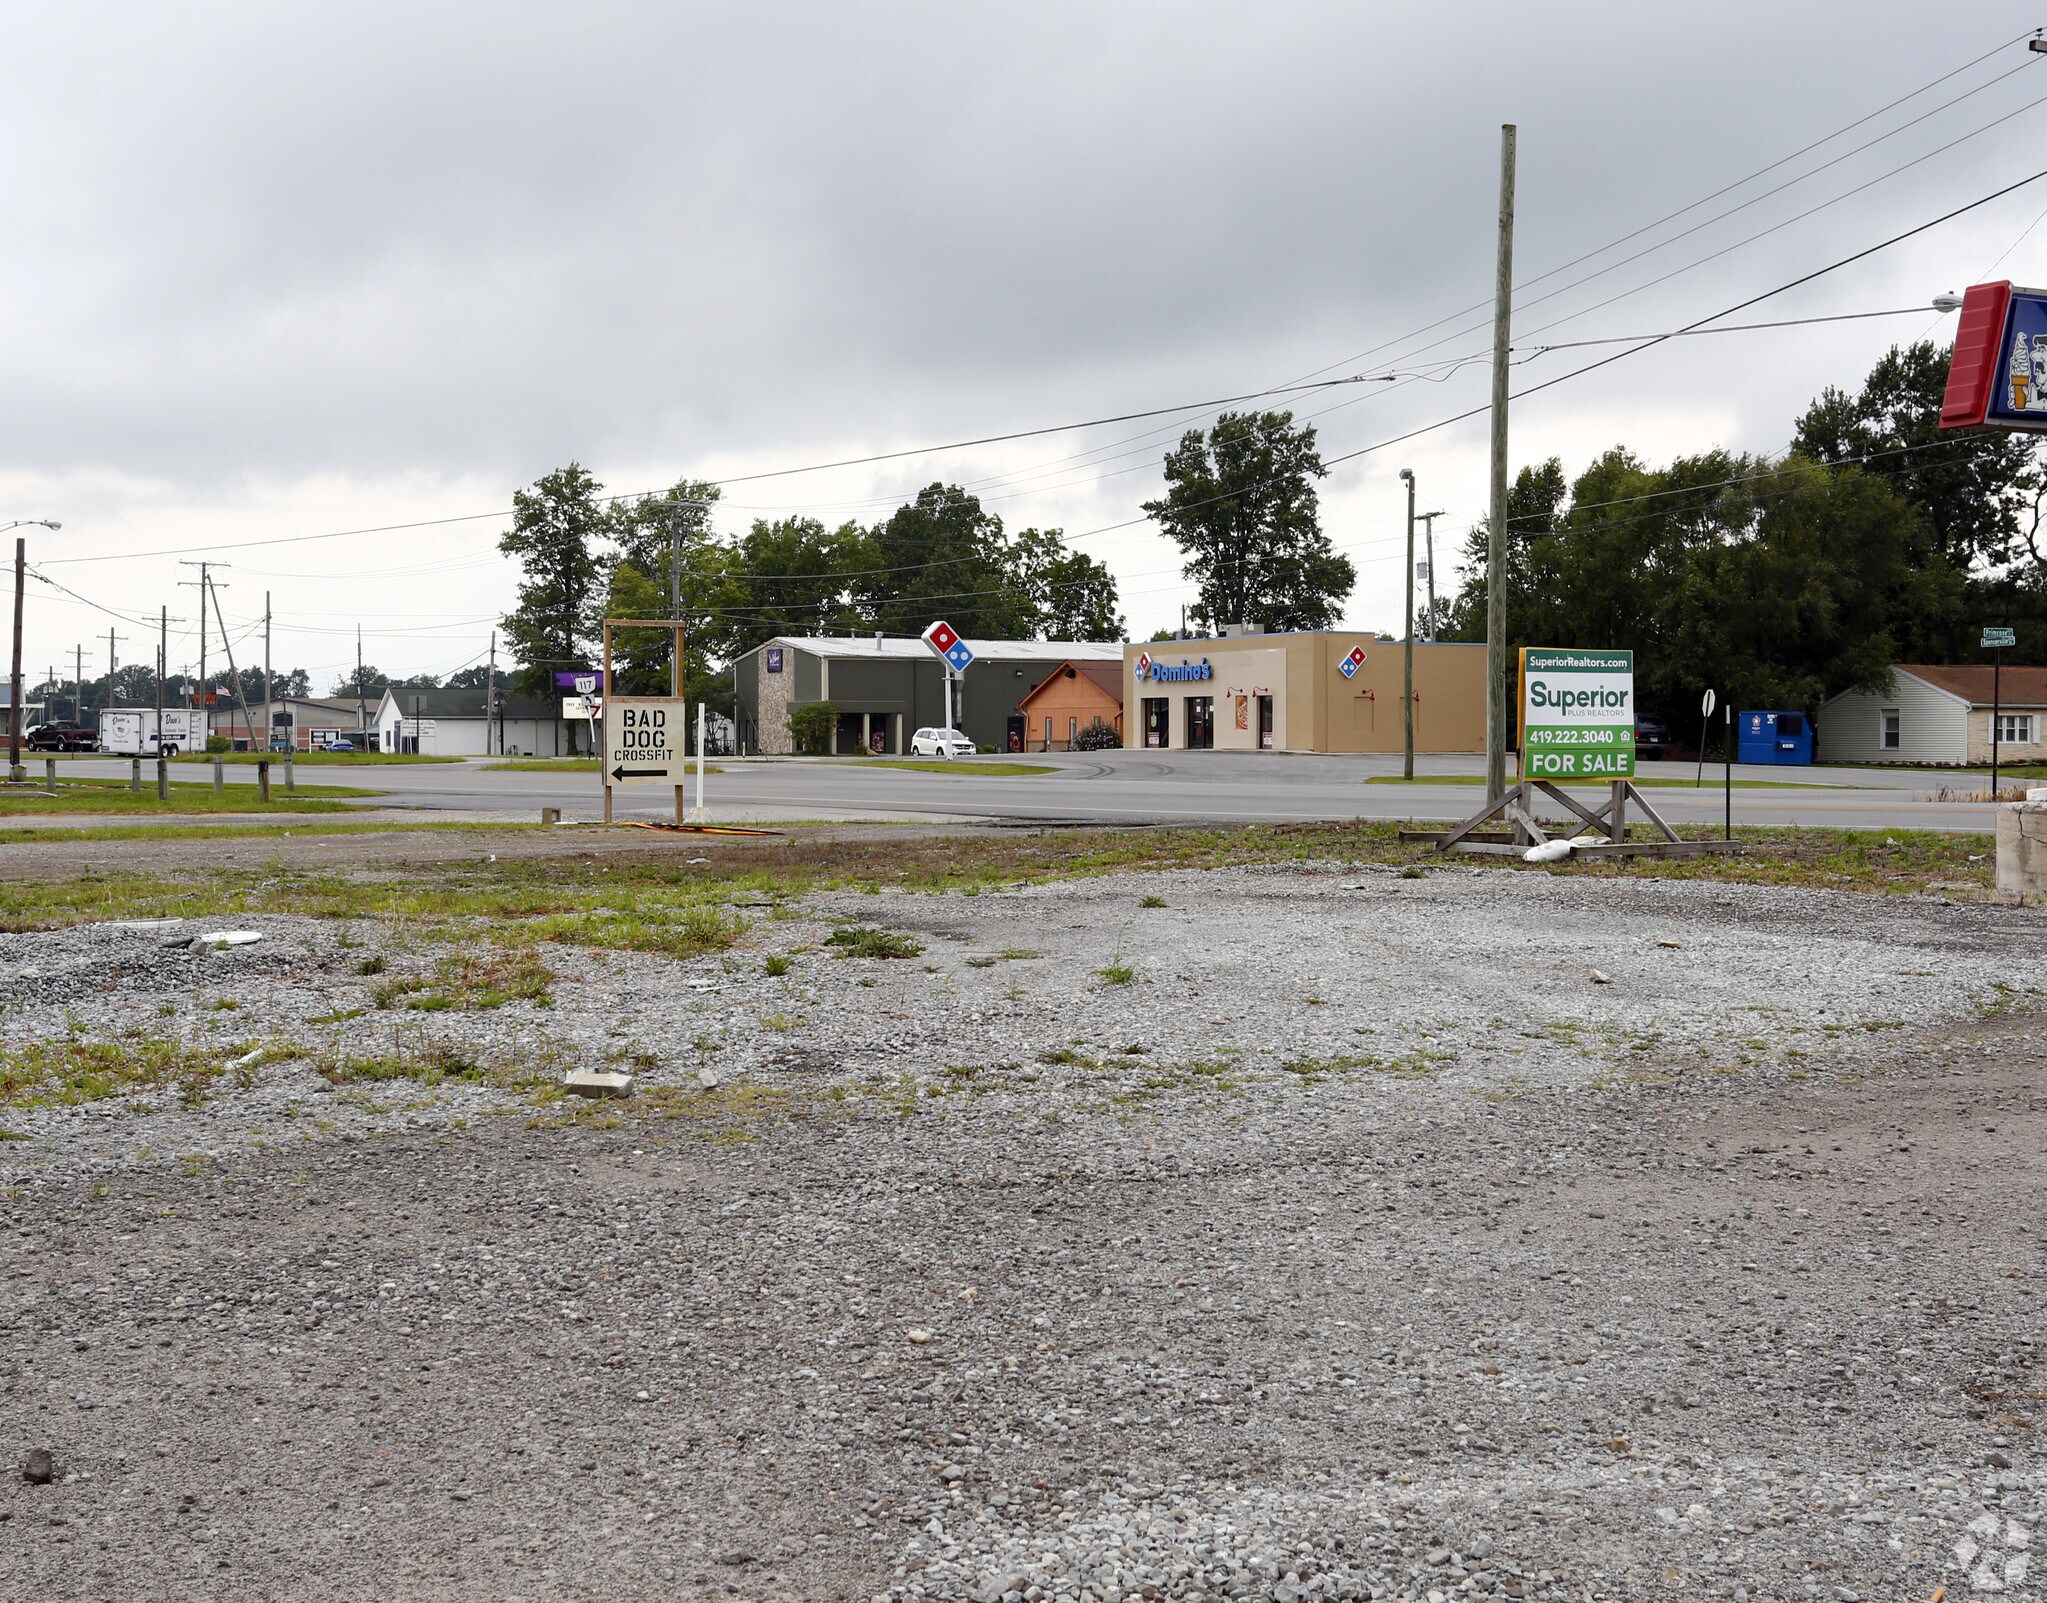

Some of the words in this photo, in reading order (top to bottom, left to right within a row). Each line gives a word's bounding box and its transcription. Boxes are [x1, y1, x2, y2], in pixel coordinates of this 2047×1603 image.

[1151, 657, 1212, 681] Domino's
[1530, 656, 1627, 669] SuperiorRealtors.com
[579, 681, 592, 690] 117
[1530, 680, 1628, 716] Superior
[623, 709, 665, 727] BAD
[1568, 709, 1586, 717] PLUS
[1587, 709, 1625, 717] REALTORS
[623, 730, 665, 748] DOG
[1530, 730, 1613, 744] 419.222.3040
[614, 749, 673, 761] CROSSFIT
[1532, 754, 1575, 772] FOR
[1582, 754, 1628, 772] SALE
